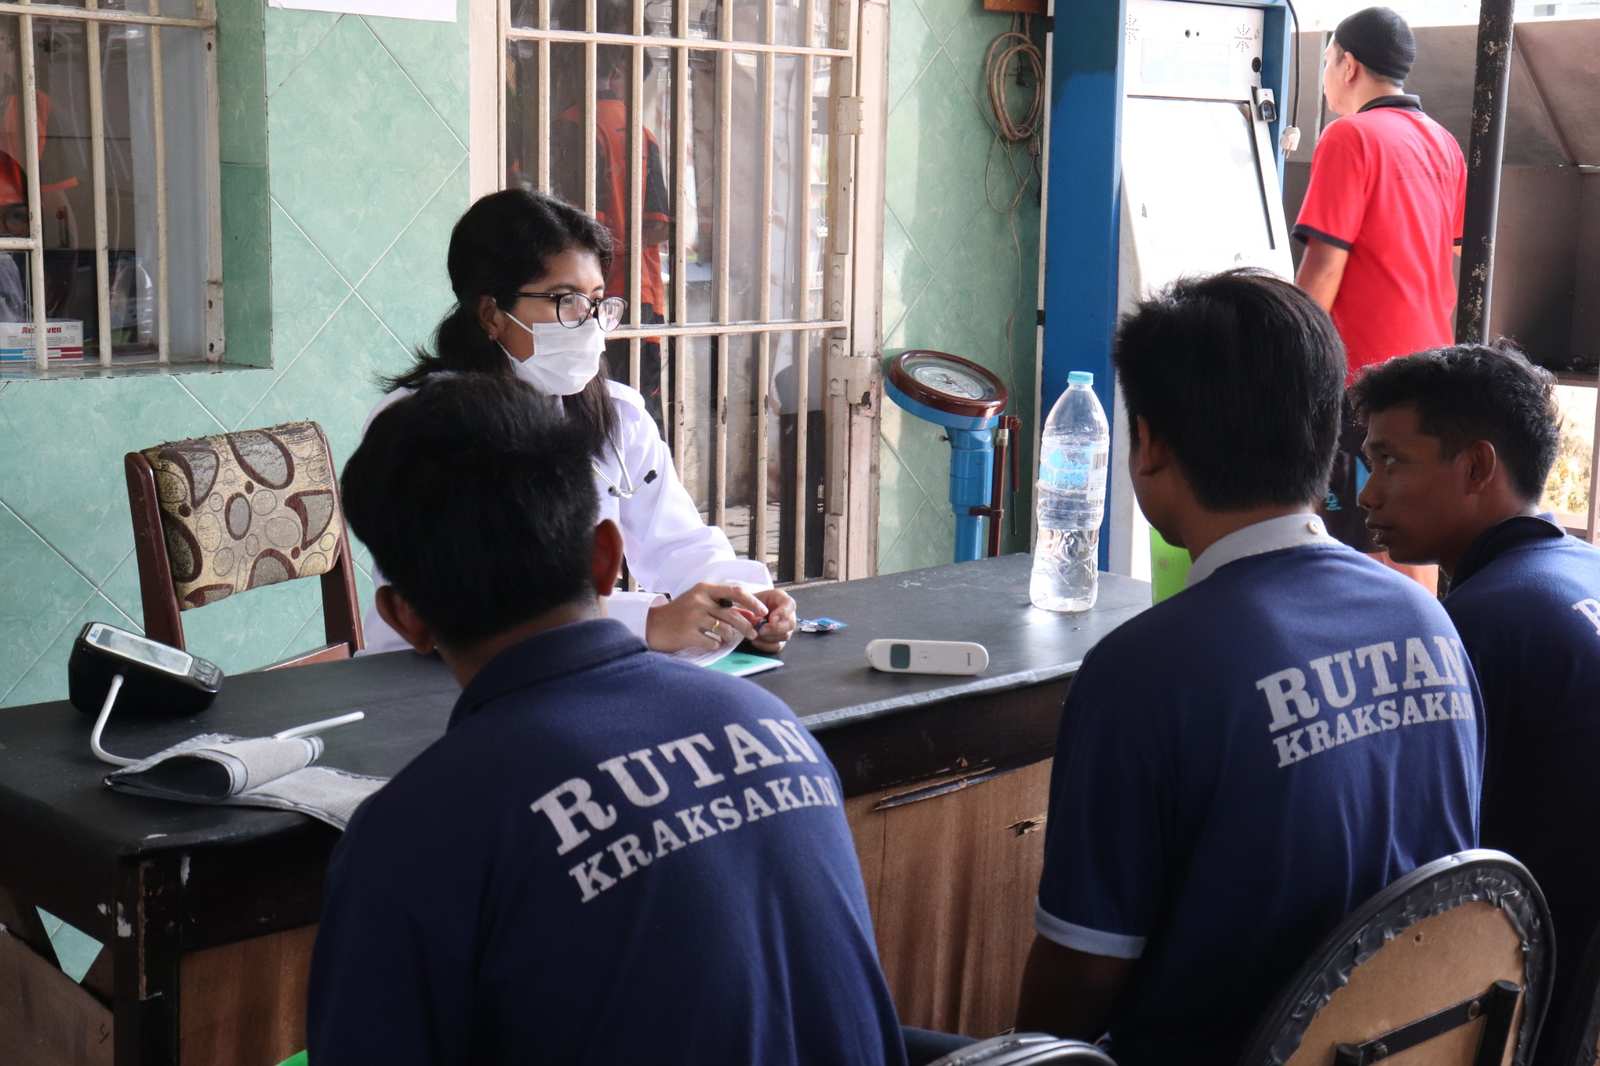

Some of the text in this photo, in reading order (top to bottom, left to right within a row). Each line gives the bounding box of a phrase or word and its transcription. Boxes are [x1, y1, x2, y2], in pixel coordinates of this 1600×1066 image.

[1255, 635, 1470, 733] RUTAN
[1272, 691, 1475, 768] KRAKSAKAN
[530, 718, 820, 856] RUTAN
[568, 775, 839, 903] KRAKSAKAN
